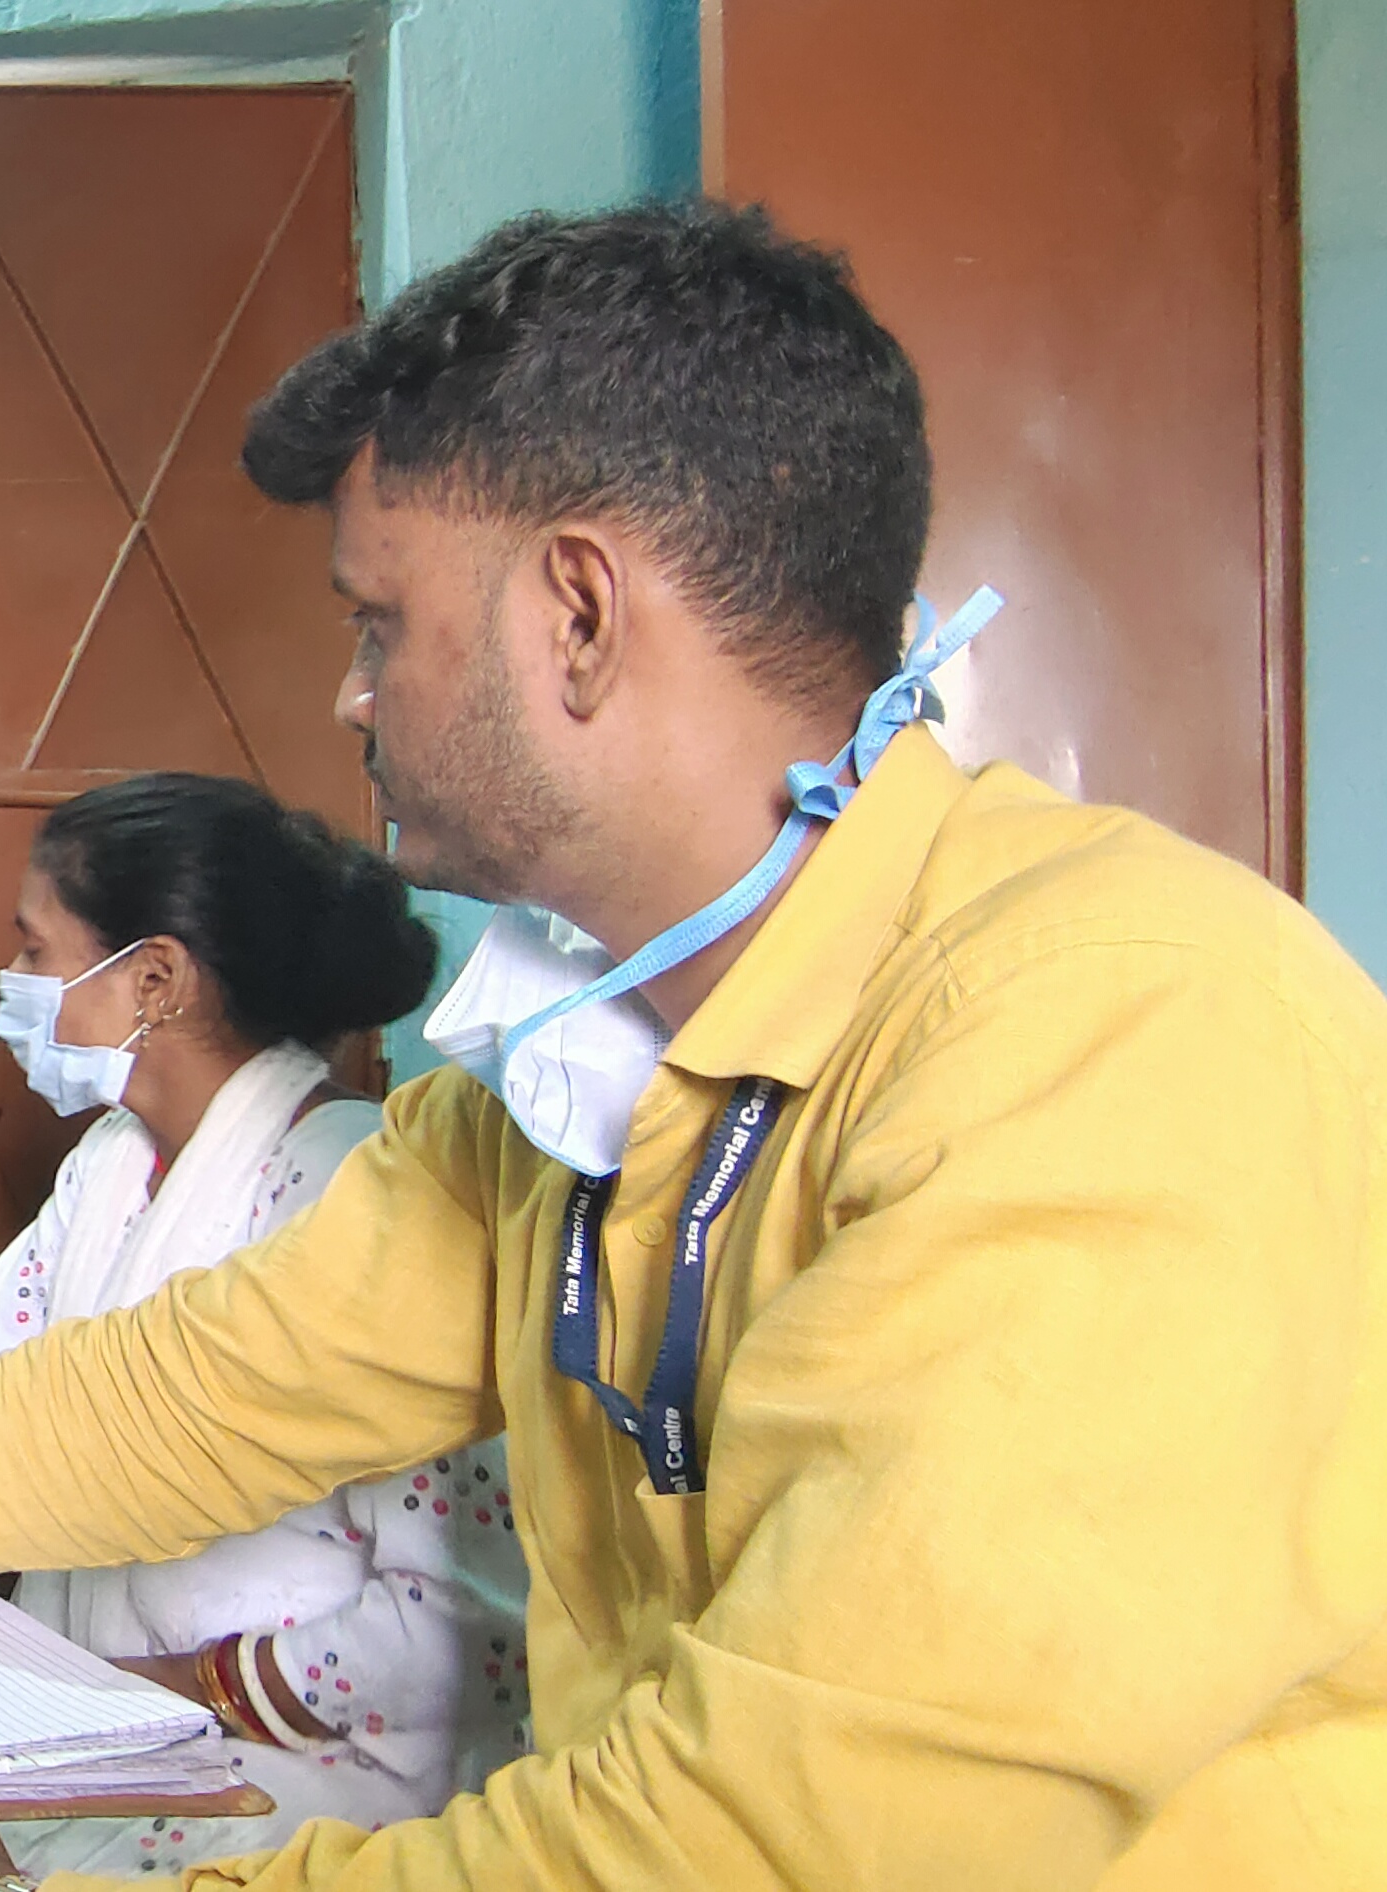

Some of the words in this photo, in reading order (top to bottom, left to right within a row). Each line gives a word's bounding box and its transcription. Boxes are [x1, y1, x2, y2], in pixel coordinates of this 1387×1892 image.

[691, 1126, 751, 1218] Memorial
[565, 1192, 591, 1274] Memorial
[684, 1221, 700, 1266] Tata
[563, 1277, 581, 1316] Tata
[663, 1407, 685, 1469] Centre
